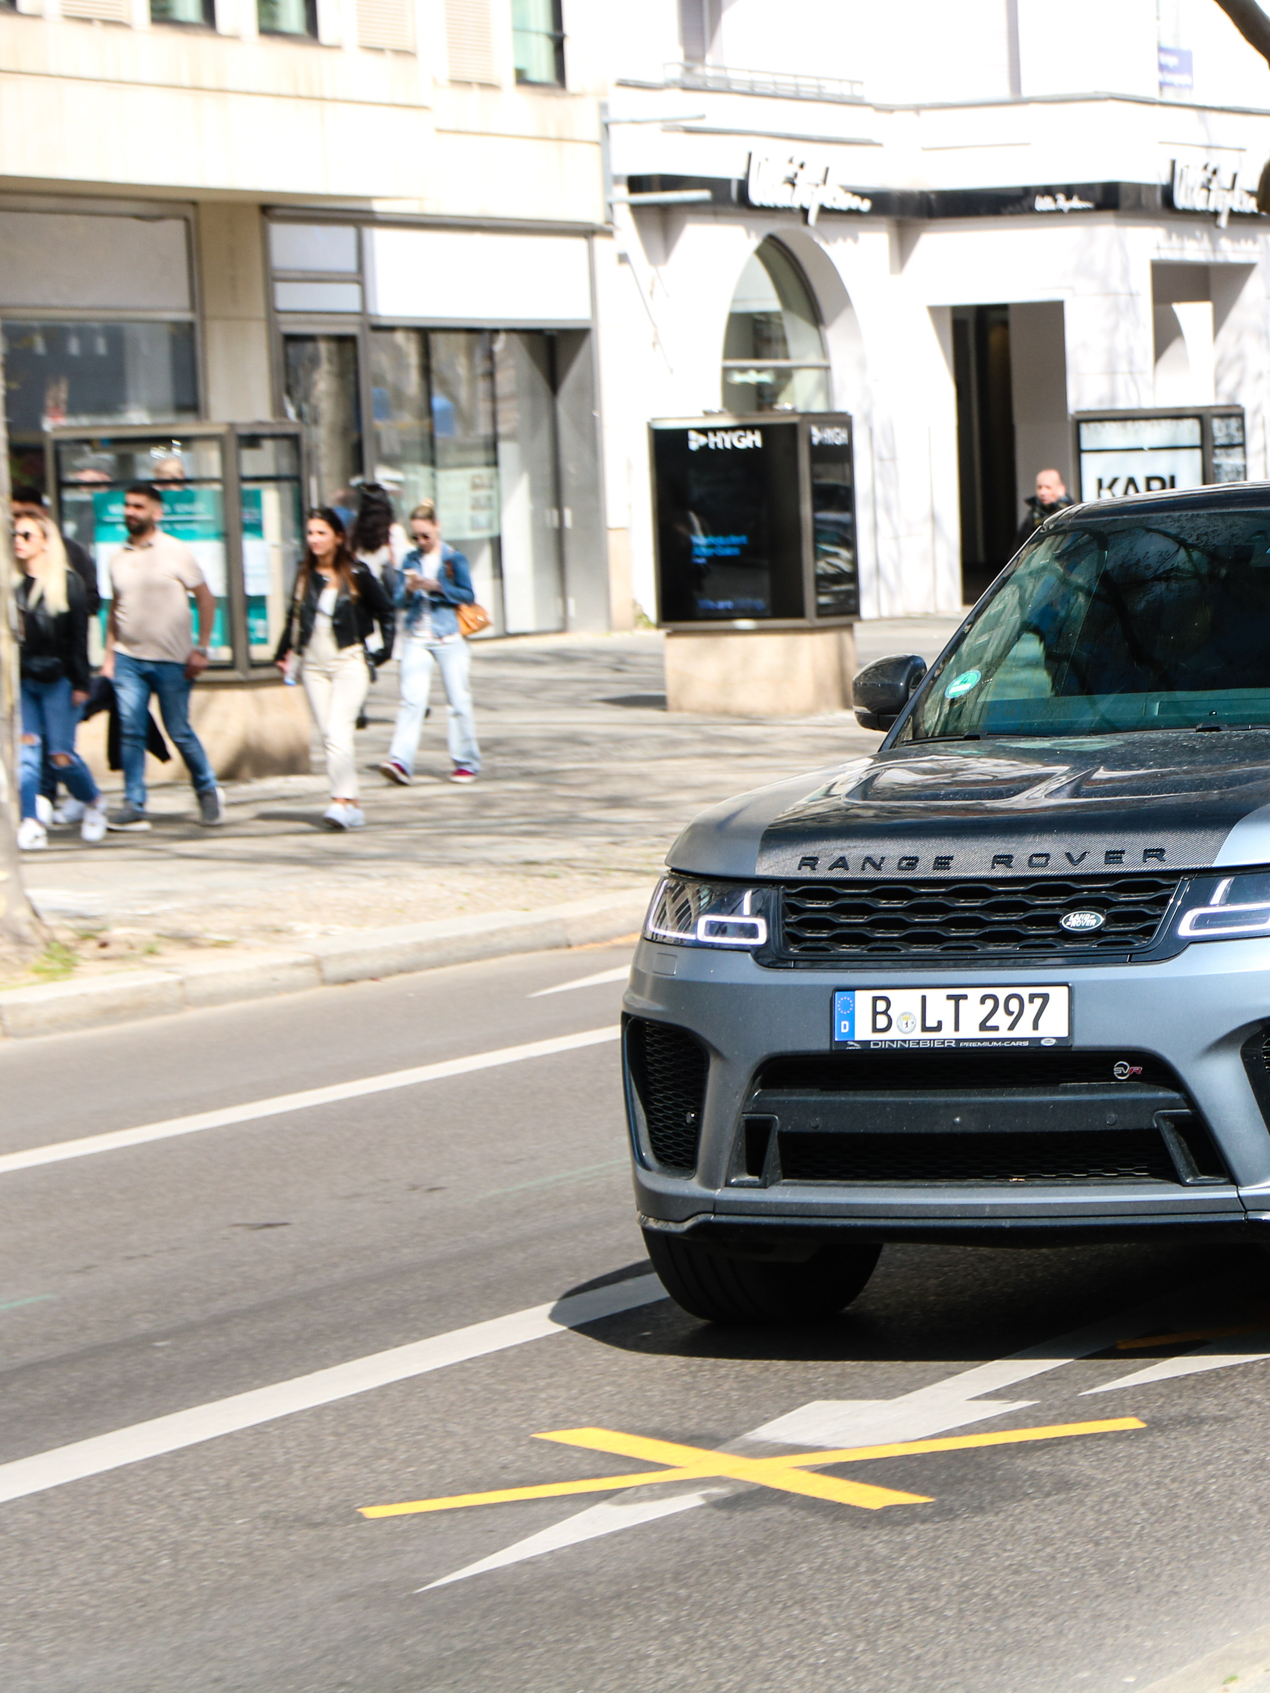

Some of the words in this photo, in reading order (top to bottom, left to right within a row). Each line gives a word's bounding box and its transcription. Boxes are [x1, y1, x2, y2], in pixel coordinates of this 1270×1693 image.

[707, 429, 762, 450] HYGH
[797, 855, 955, 872] RANGE
[990, 848, 1167, 869] ROVER
[871, 995, 893, 1034] B
[921, 994, 968, 1033] LT
[979, 992, 1050, 1032] 297
[840, 1020, 849, 1033] D
[870, 1039, 956, 1049] DINNEBIER
[959, 1040, 1029, 1048] PREMIUM-CARS
[1113, 1064, 1143, 1076] SVR
